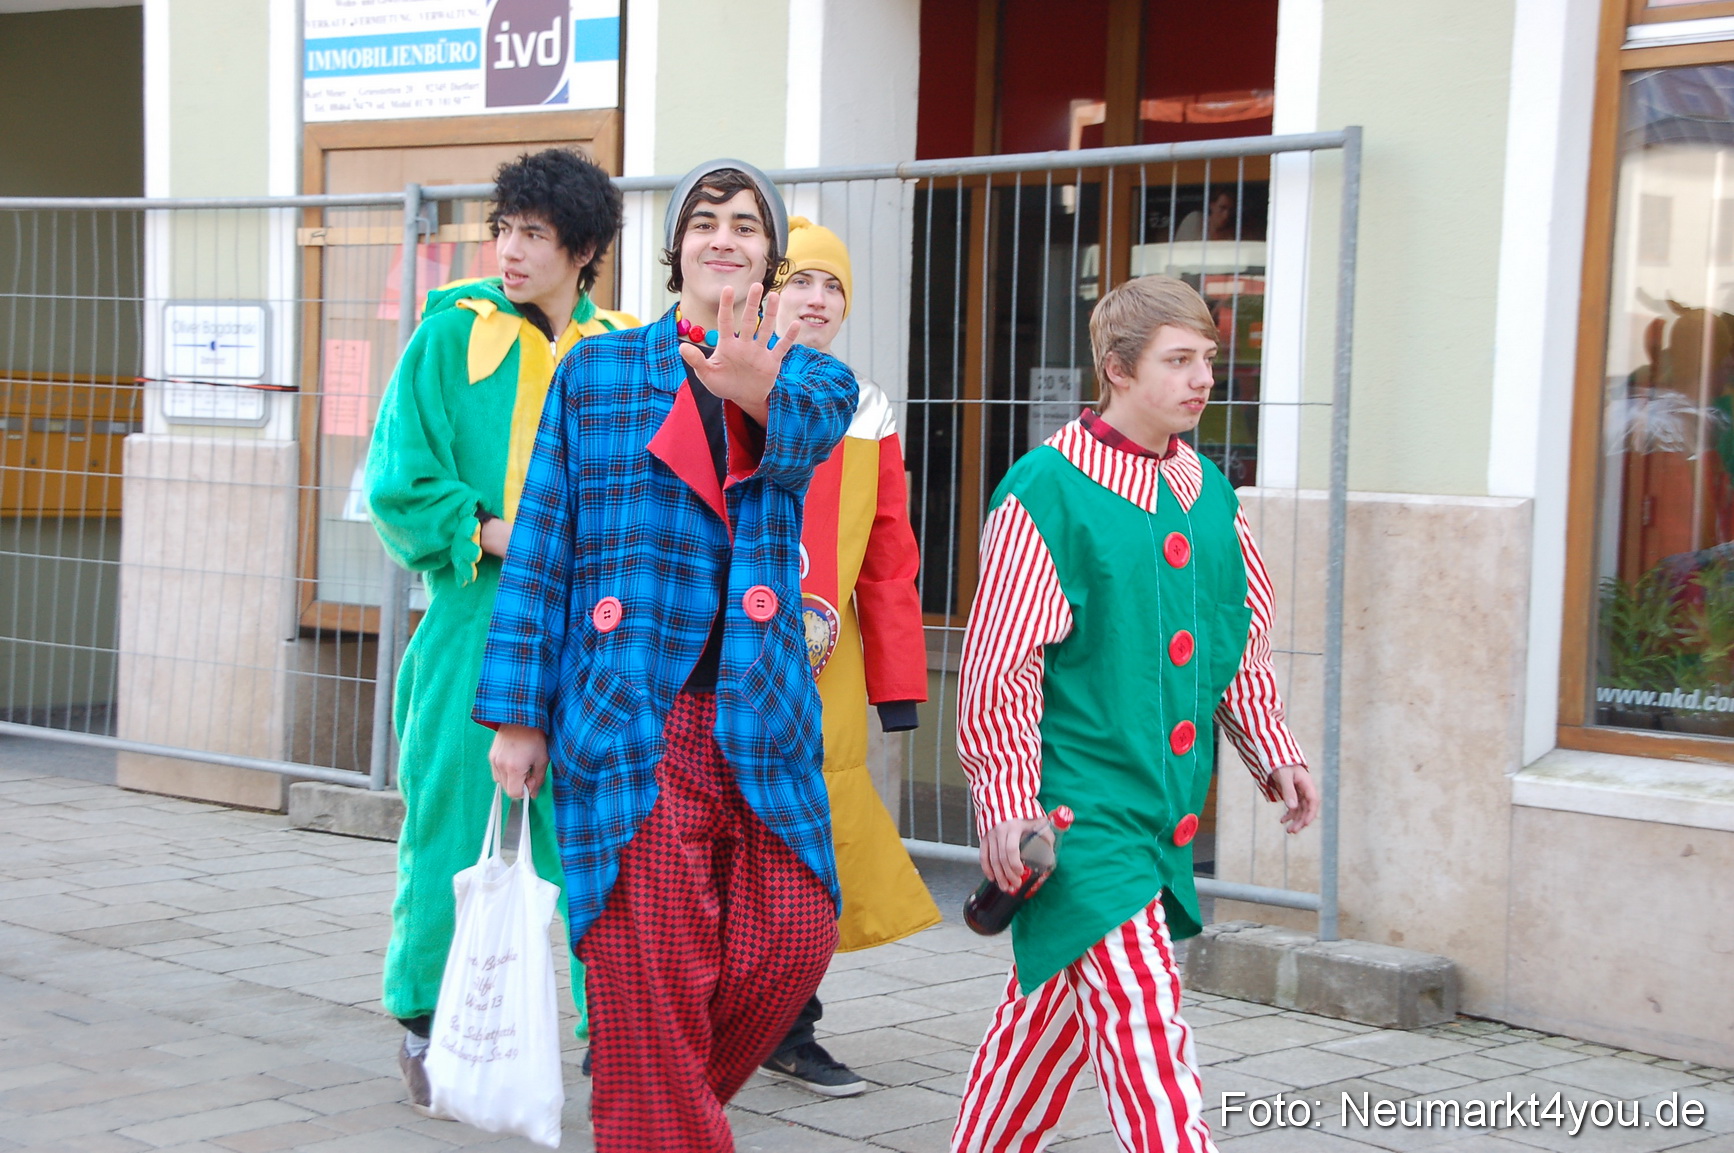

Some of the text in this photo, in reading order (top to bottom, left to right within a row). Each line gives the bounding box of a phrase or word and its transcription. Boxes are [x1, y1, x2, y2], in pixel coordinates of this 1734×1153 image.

[307, 38, 478, 71] IMMOBILIENBÜRO
[493, 15, 562, 70] ivd
[1596, 686, 1734, 712] www.nkd.co
